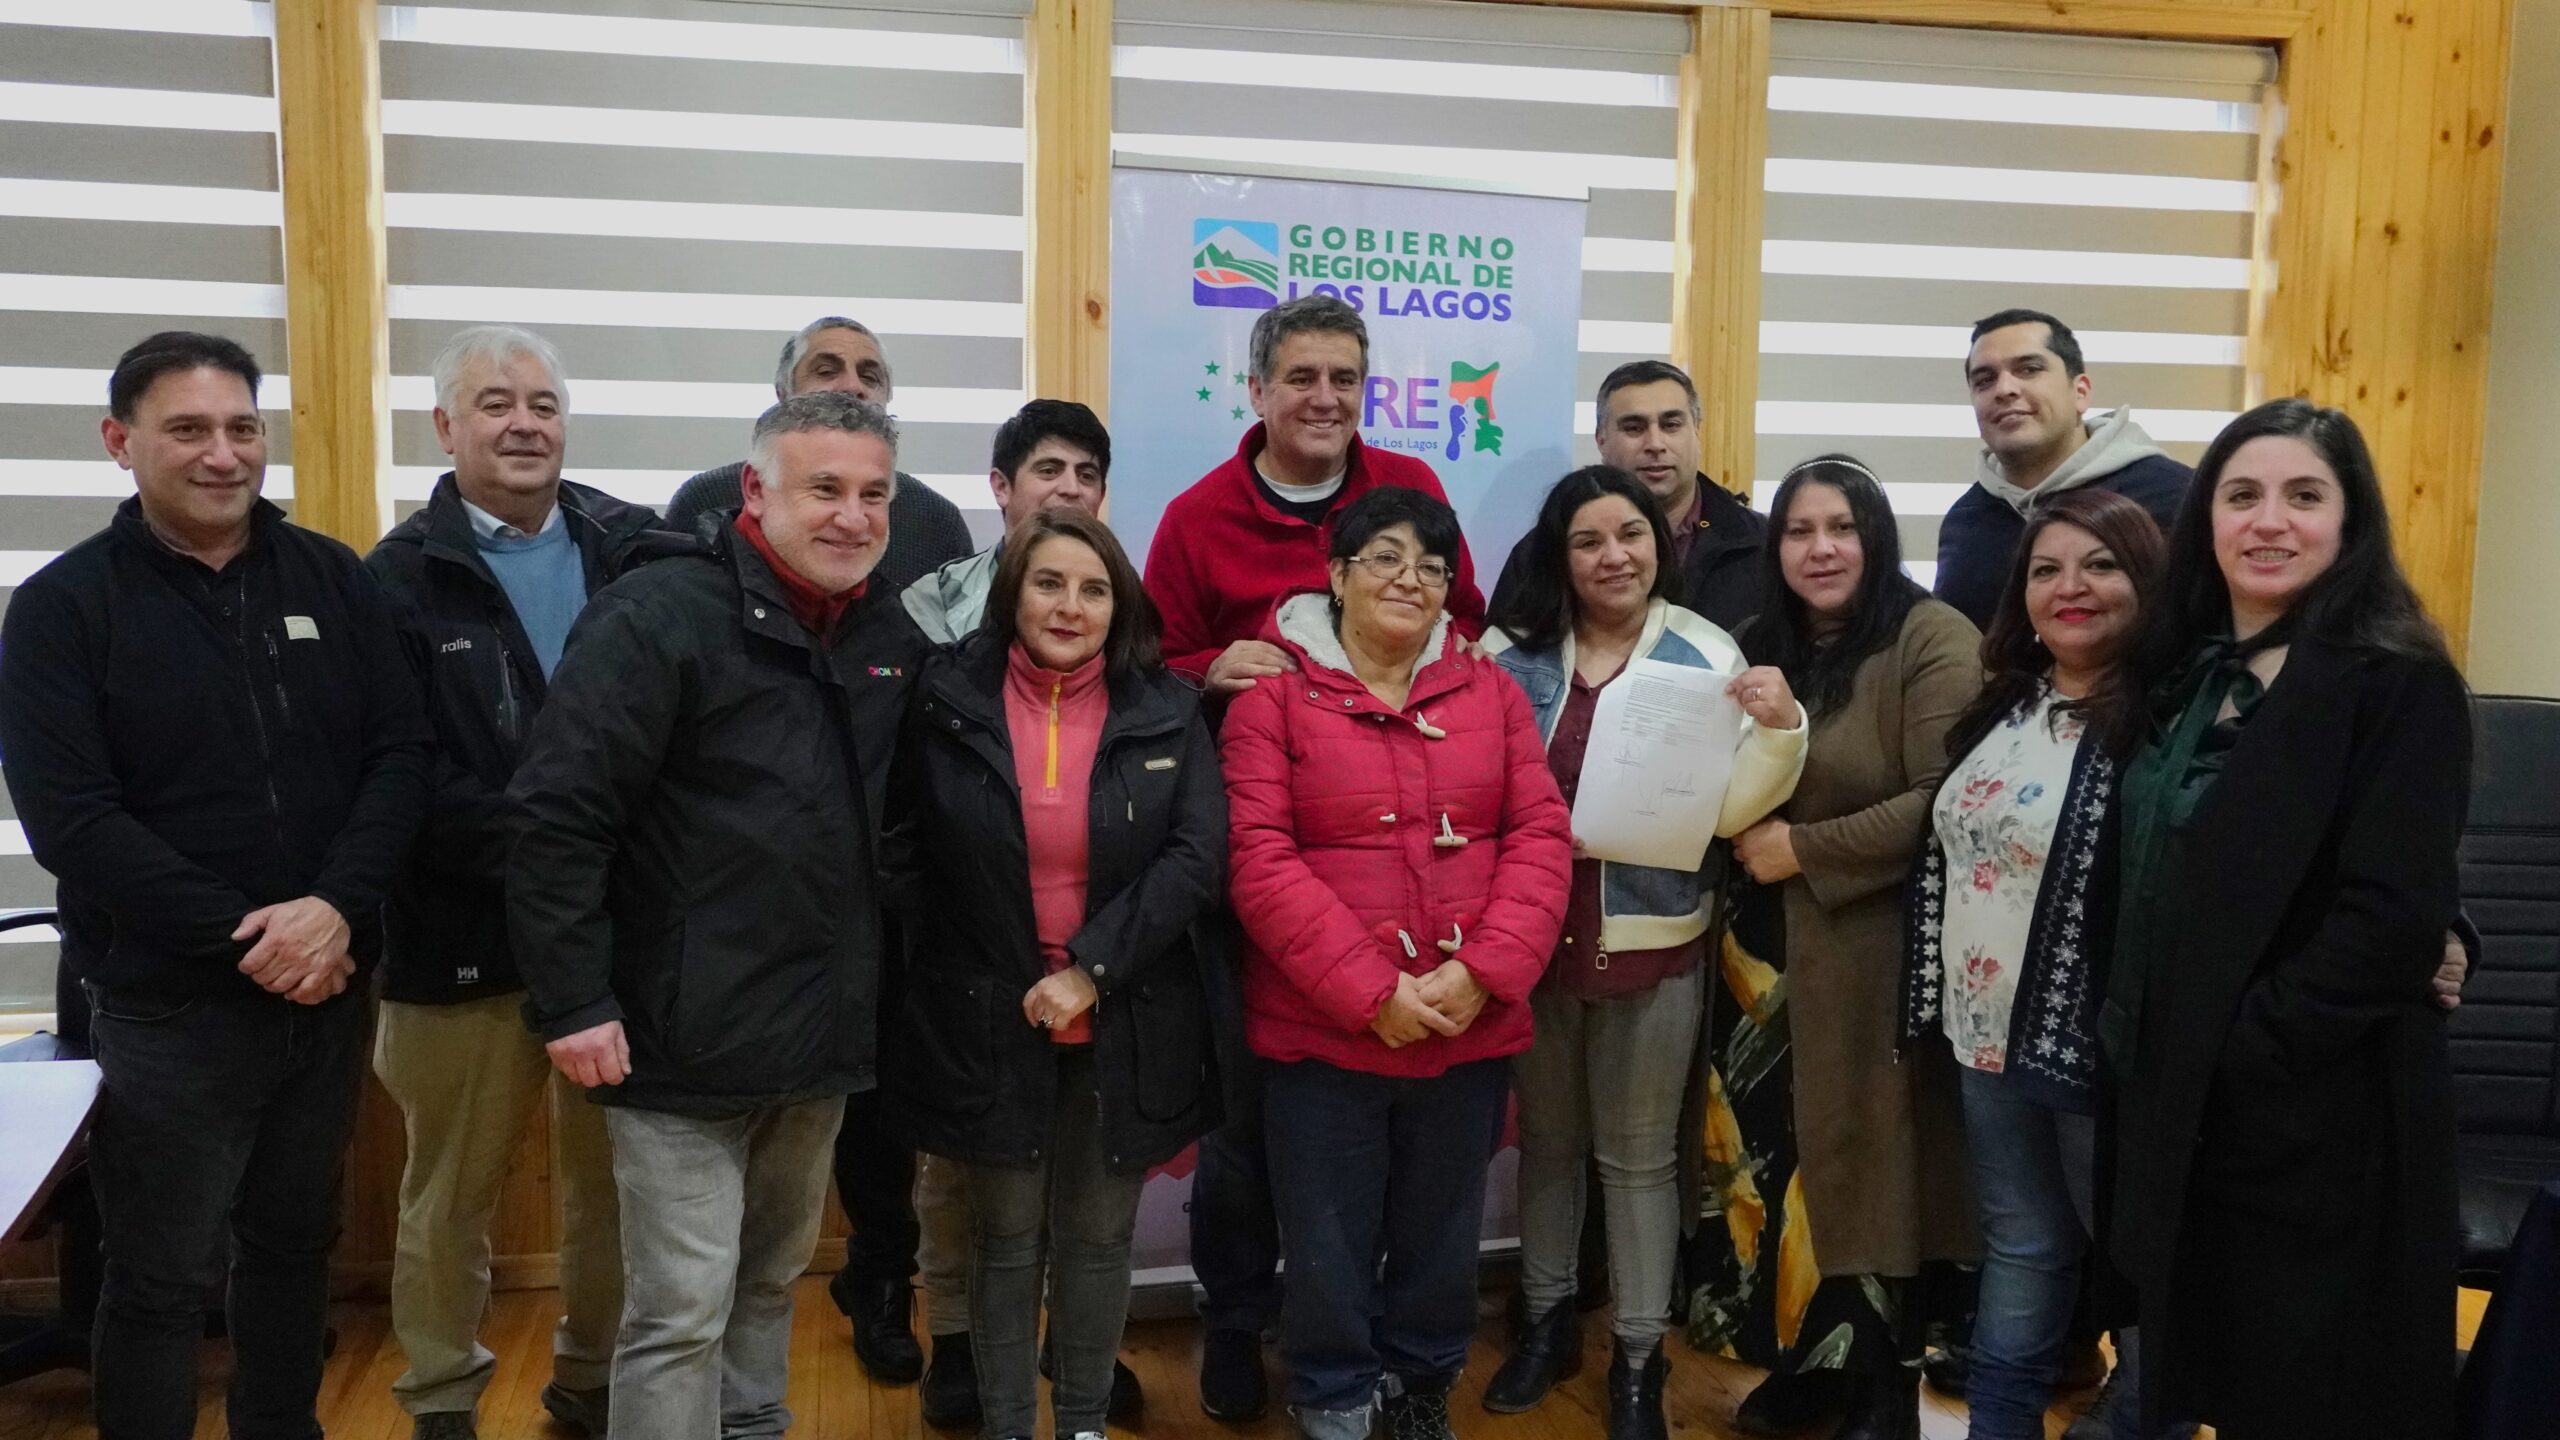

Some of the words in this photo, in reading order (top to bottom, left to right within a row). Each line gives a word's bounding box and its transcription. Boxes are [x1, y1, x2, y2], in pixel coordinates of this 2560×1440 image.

[1289, 224, 1514, 261] GOBIERNO
[1289, 252, 1461, 286] REGIONAL
[1473, 264, 1513, 289] DE
[1378, 286, 1512, 322] LAGOS
[1366, 436, 1380, 448] de
[1384, 436, 1403, 448] Los
[1407, 437, 1438, 452] Lagos
[440, 637, 472, 653] ralis
[457, 967, 478, 979] HH
